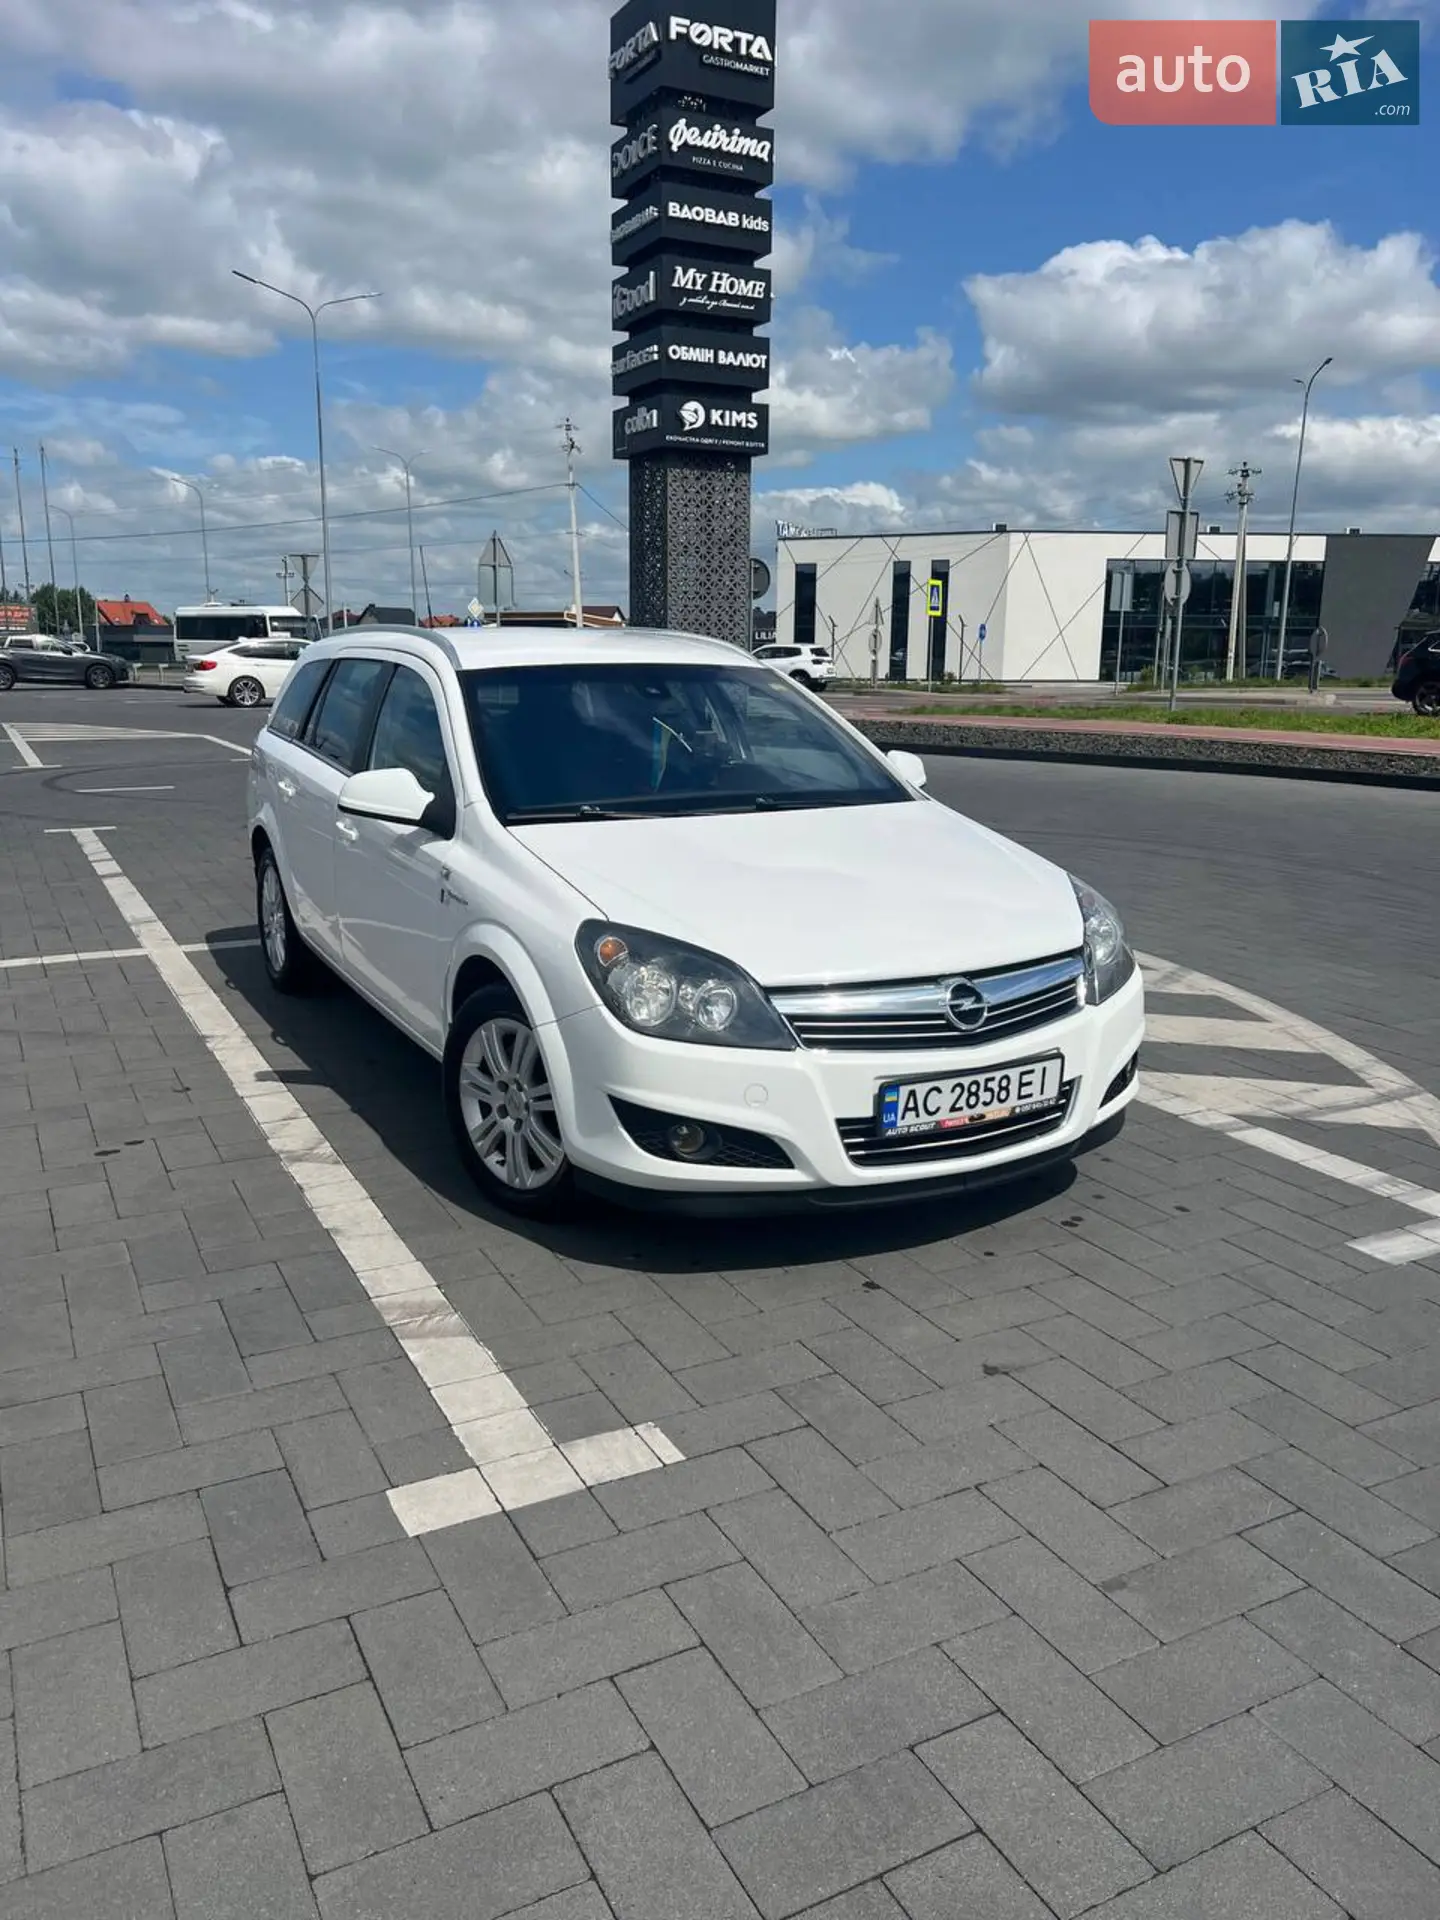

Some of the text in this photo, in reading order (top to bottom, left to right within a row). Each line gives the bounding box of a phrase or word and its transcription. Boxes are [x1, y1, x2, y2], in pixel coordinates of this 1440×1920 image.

[669, 15, 773, 61] FORTA
[702, 54, 770, 76] GASTROMARKET
[668, 201, 740, 227] BAOBAB
[742, 214, 770, 232] kids
[668, 344, 768, 369] ОБМІН ВАЛЮТ
[710, 408, 759, 429] KIMS
[901, 1085, 943, 1121] AC
[950, 1074, 1011, 1113] 2858
[1016, 1066, 1047, 1100] EI
[882, 1112, 896, 1124] UA
[885, 1127, 908, 1137] AUTO
